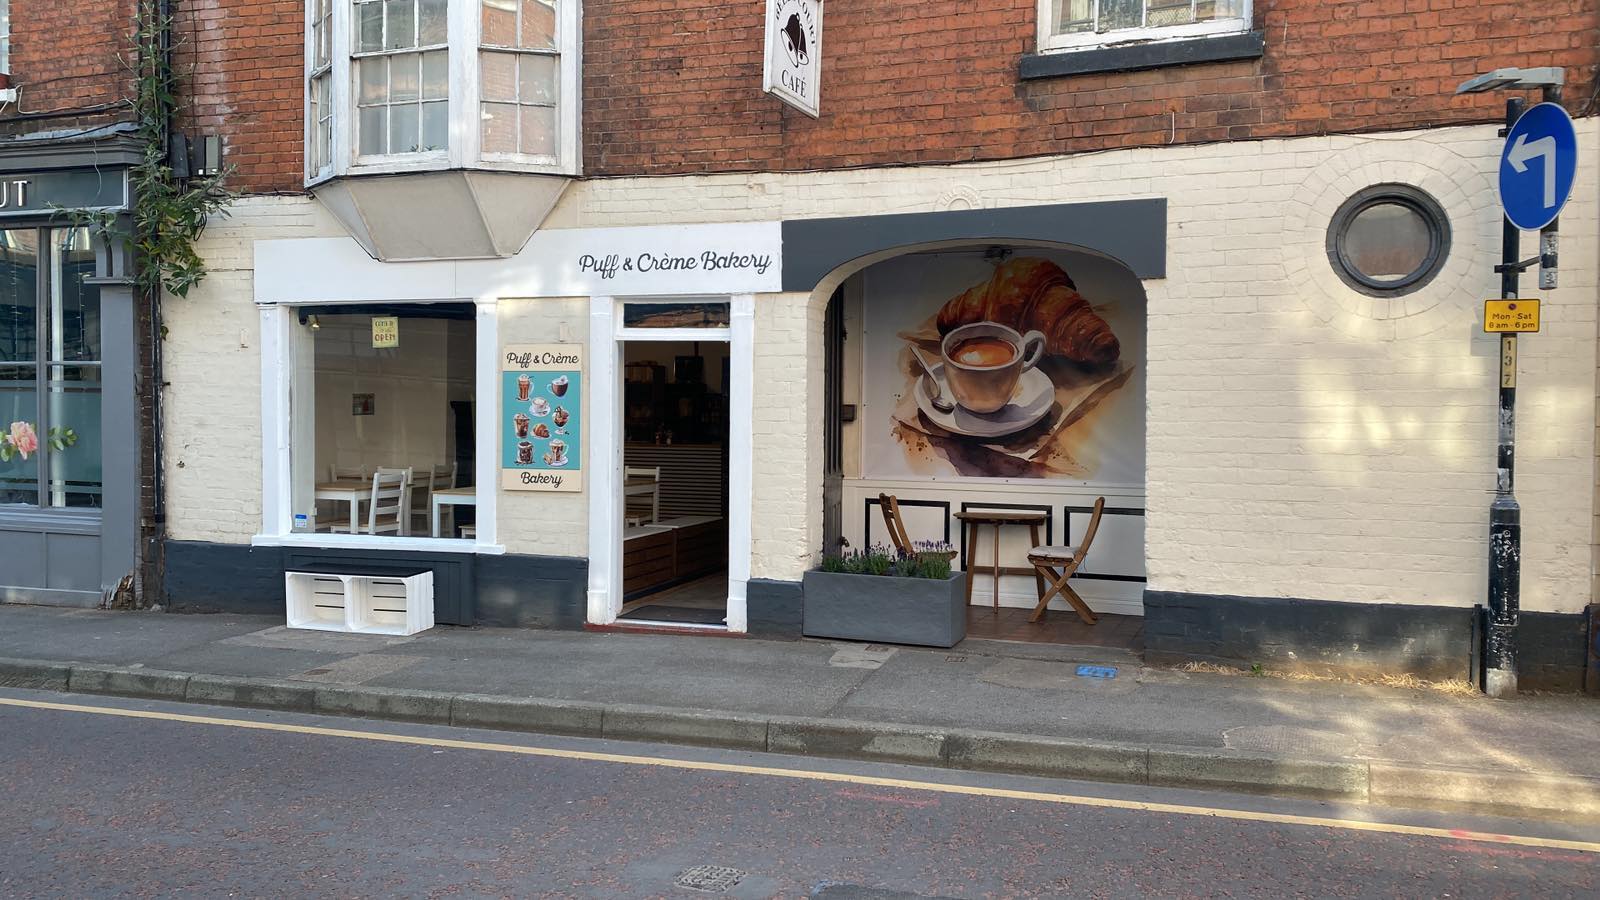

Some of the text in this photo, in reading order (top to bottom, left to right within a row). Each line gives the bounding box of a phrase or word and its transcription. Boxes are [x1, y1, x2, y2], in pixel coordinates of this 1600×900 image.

[776, 0, 791, 20] BEL
[781, 69, 807, 98] CAFÉ
[578, 250, 772, 280] Puff & Crème Bakery
[1517, 312, 1532, 320] Sat
[374, 333, 396, 342] OPEN
[506, 352, 532, 369] Puff
[541, 352, 579, 365] Crème
[520, 471, 563, 489] Bakery
